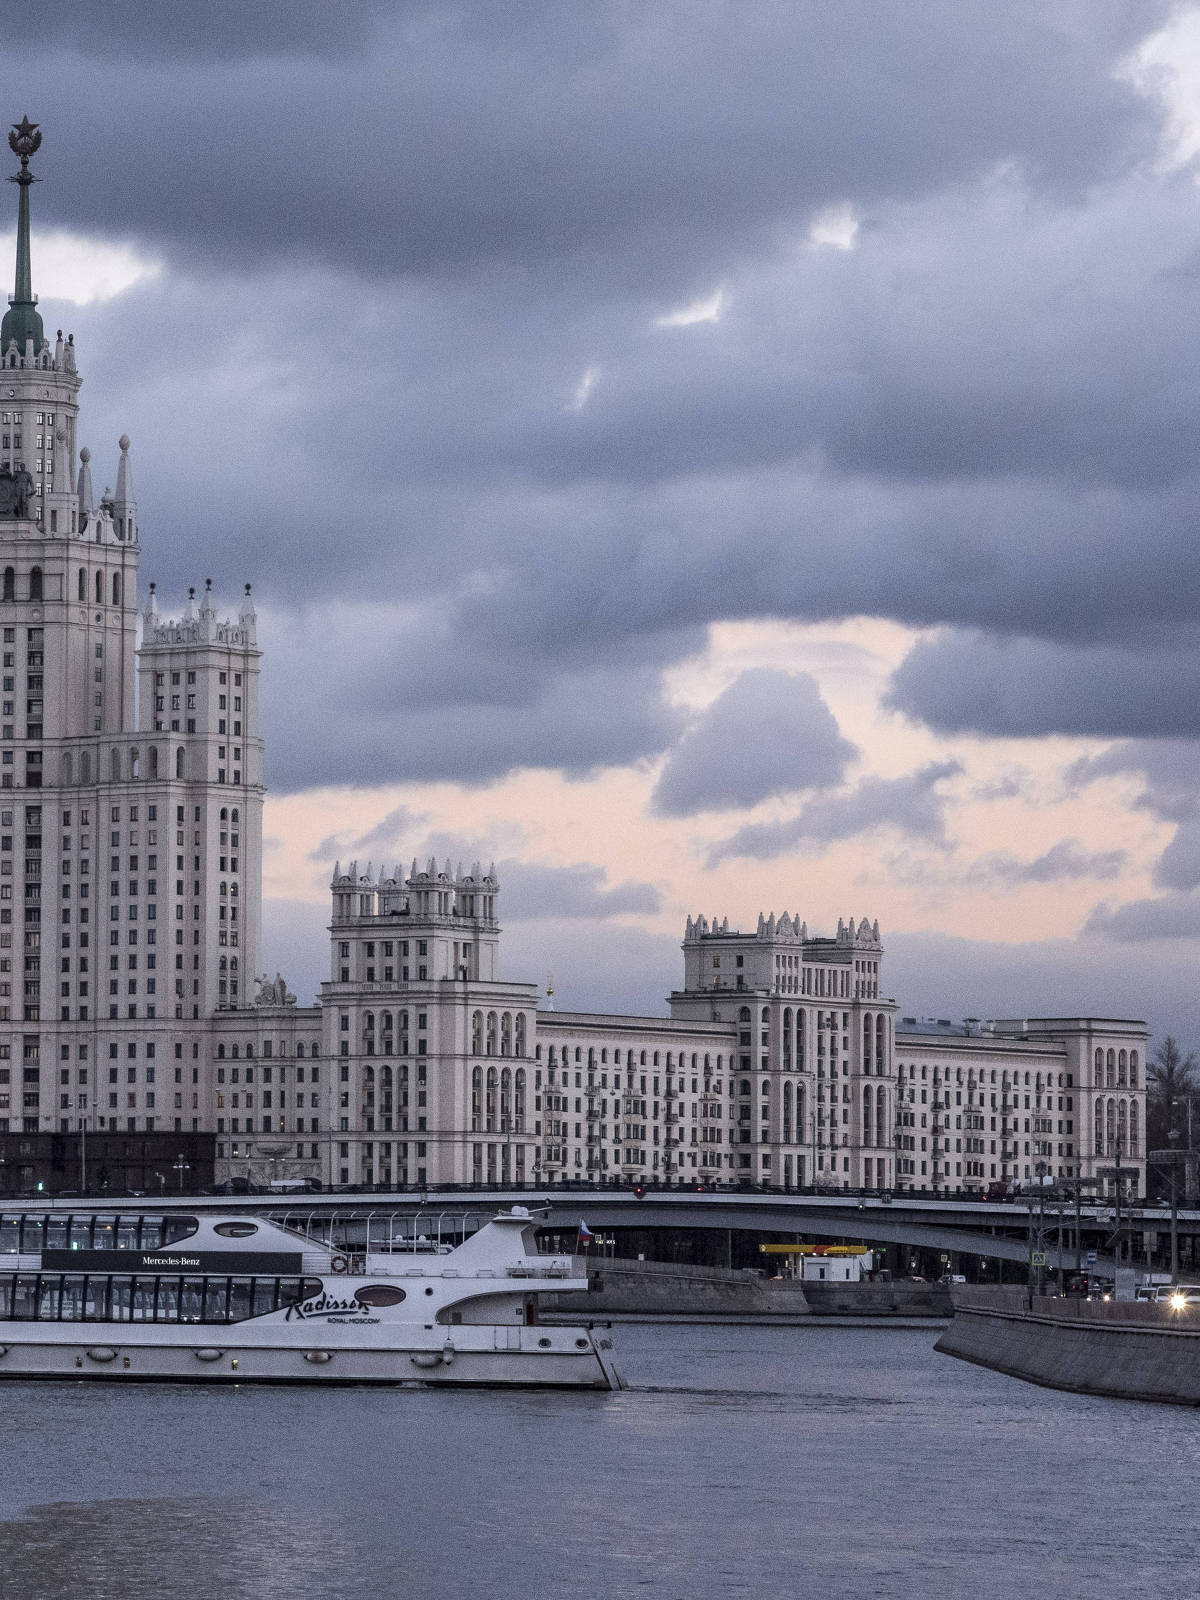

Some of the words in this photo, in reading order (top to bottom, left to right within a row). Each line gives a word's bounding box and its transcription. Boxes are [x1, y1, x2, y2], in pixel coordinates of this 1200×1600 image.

[142, 1256, 200, 1266] Mercedes-Benz
[285, 1291, 370, 1321] Radisson
[349, 1317, 380, 1325] MOSCOW
